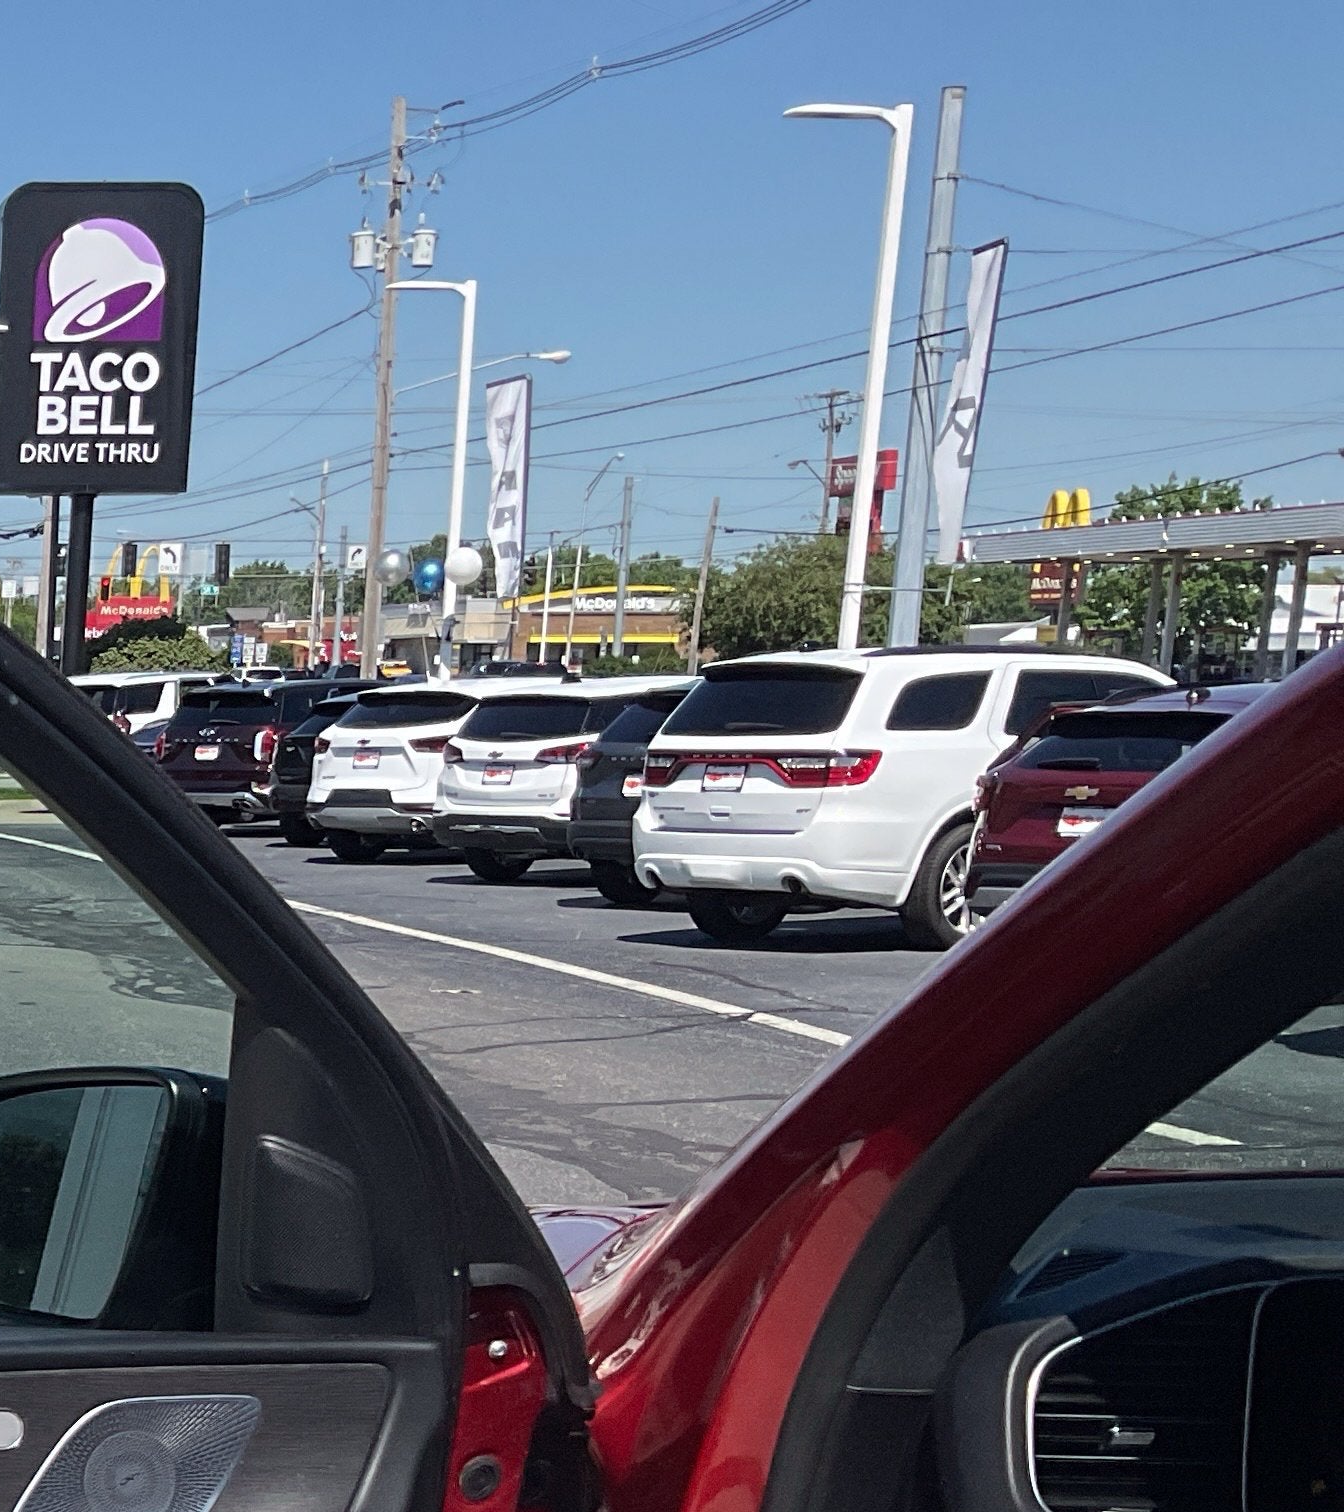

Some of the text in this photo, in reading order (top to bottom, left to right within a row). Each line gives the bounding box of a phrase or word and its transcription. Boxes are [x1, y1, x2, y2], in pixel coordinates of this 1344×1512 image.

[29, 351, 161, 393] TACO
[35, 395, 155, 436] BELL
[19, 442, 160, 464] DRIVE THRU
